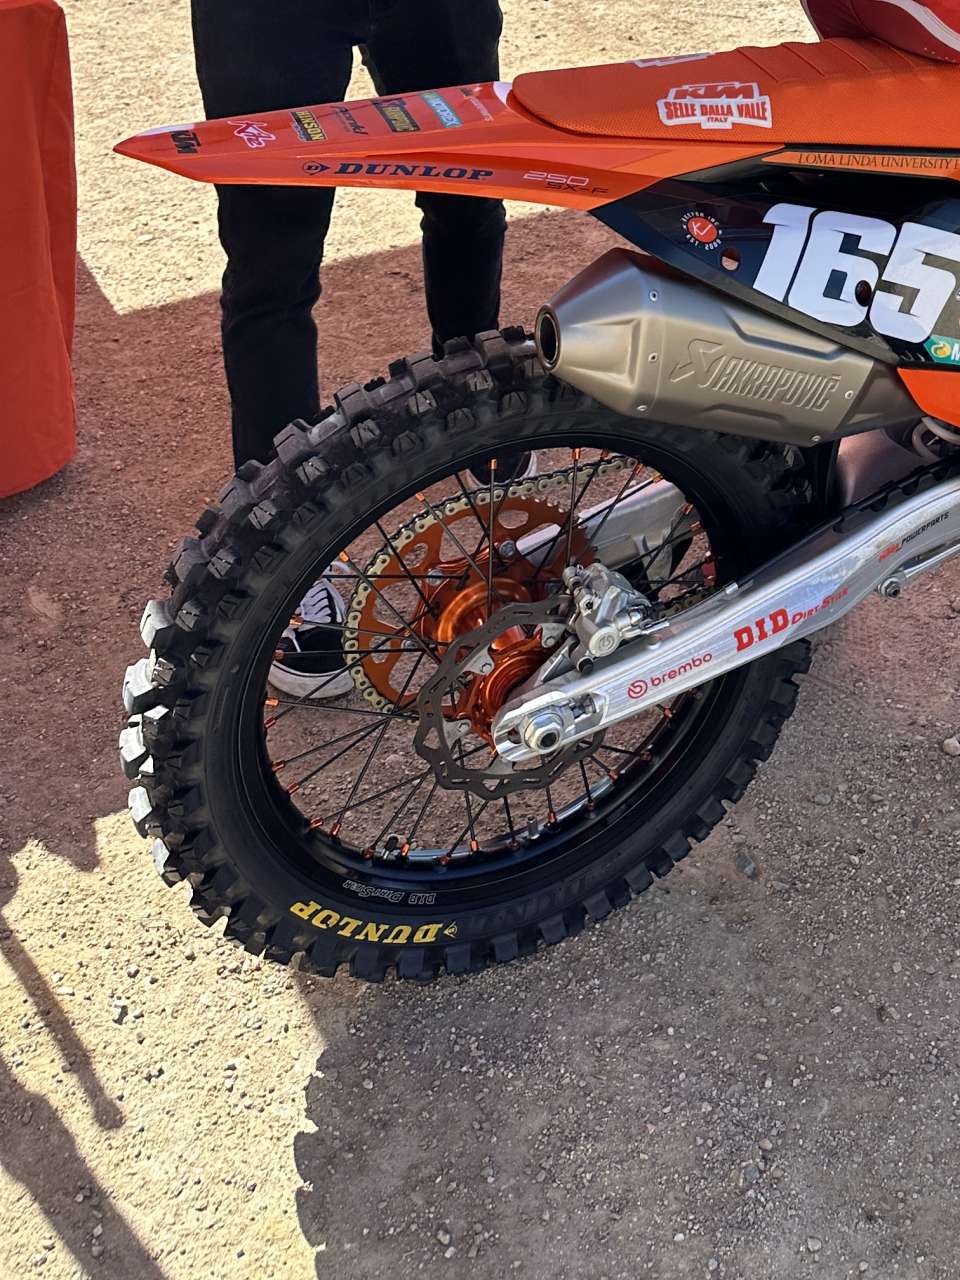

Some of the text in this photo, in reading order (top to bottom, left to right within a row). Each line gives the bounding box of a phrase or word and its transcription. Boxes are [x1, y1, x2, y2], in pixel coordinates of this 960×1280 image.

[672, 84, 755, 100] KTM
[664, 101, 768, 120] SELLE DALLA VALLE
[297, 110, 326, 141] HINSON
[170, 129, 202, 155] KTM
[798, 152, 837, 166] LOMA
[839, 154, 878, 168] LINDA
[881, 155, 952, 169] UNIVERSITY
[333, 162, 494, 180] DUNLOP
[523, 170, 590, 186] 250
[651, 652, 713, 687] brembo
[289, 900, 445, 945] DUNLOP
